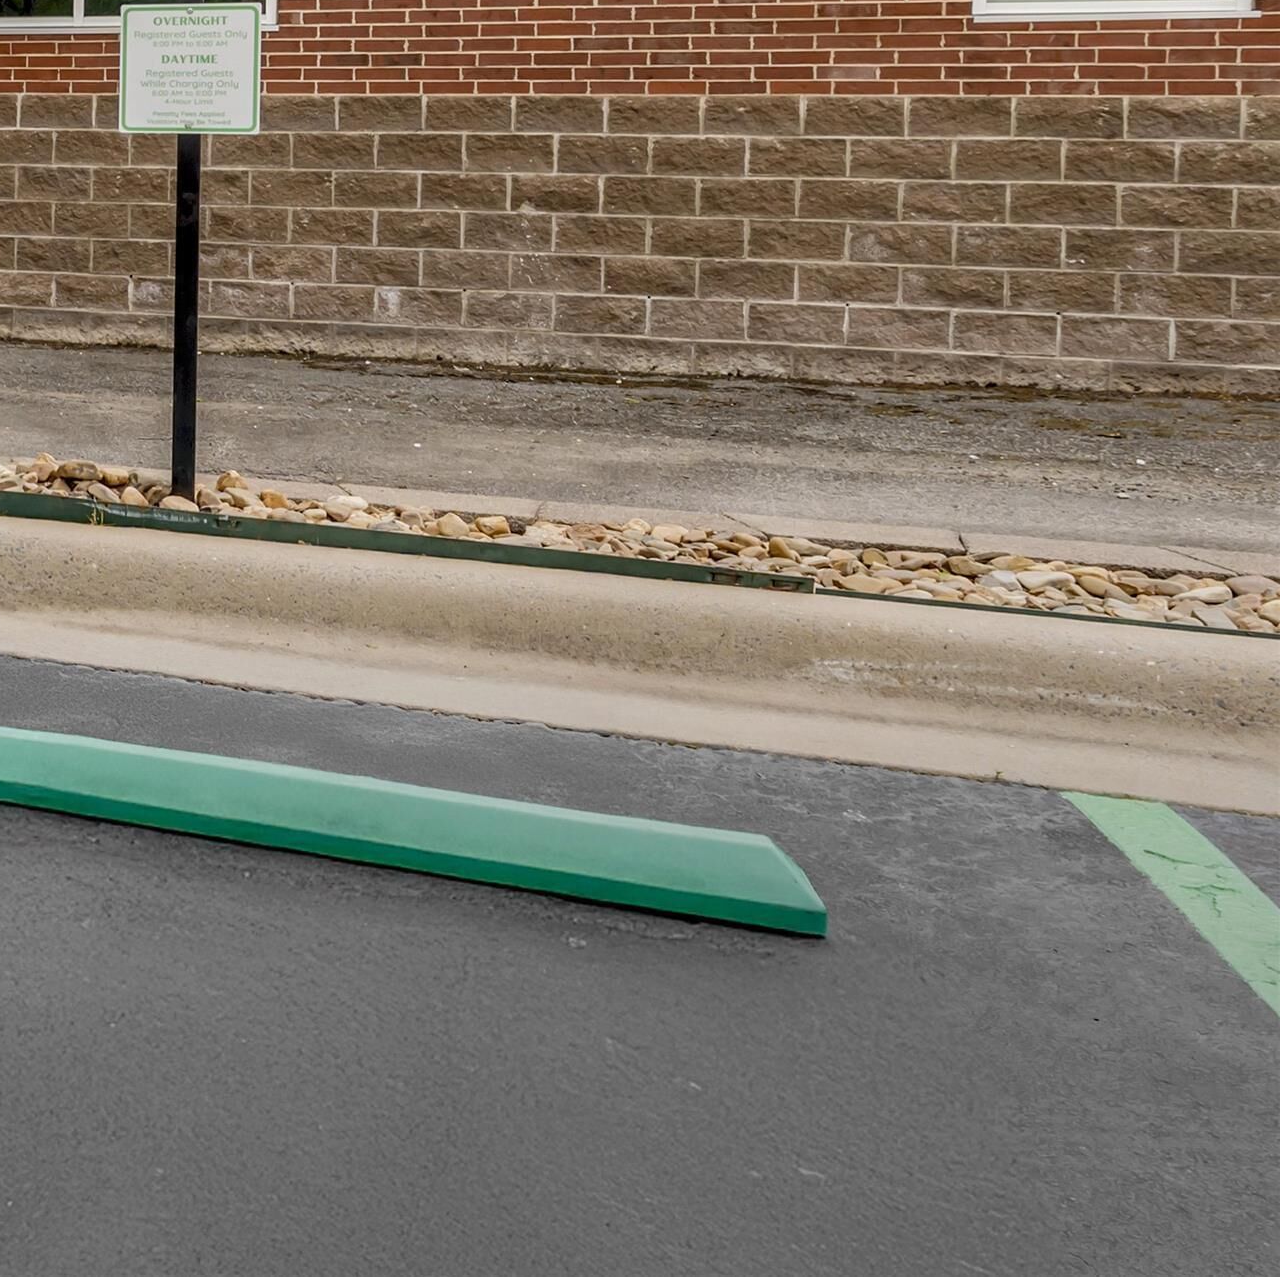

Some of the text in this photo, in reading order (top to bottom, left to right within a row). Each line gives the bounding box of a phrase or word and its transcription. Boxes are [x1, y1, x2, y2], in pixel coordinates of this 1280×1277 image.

[153, 15, 229, 27] OVERNIGHT
[134, 30, 248, 40] Registered Guests Only
[161, 54, 219, 64] DAYTIME
[146, 69, 234, 79] Registered Guests
[169, 80, 214, 89] Charging
[216, 80, 239, 89] Only
